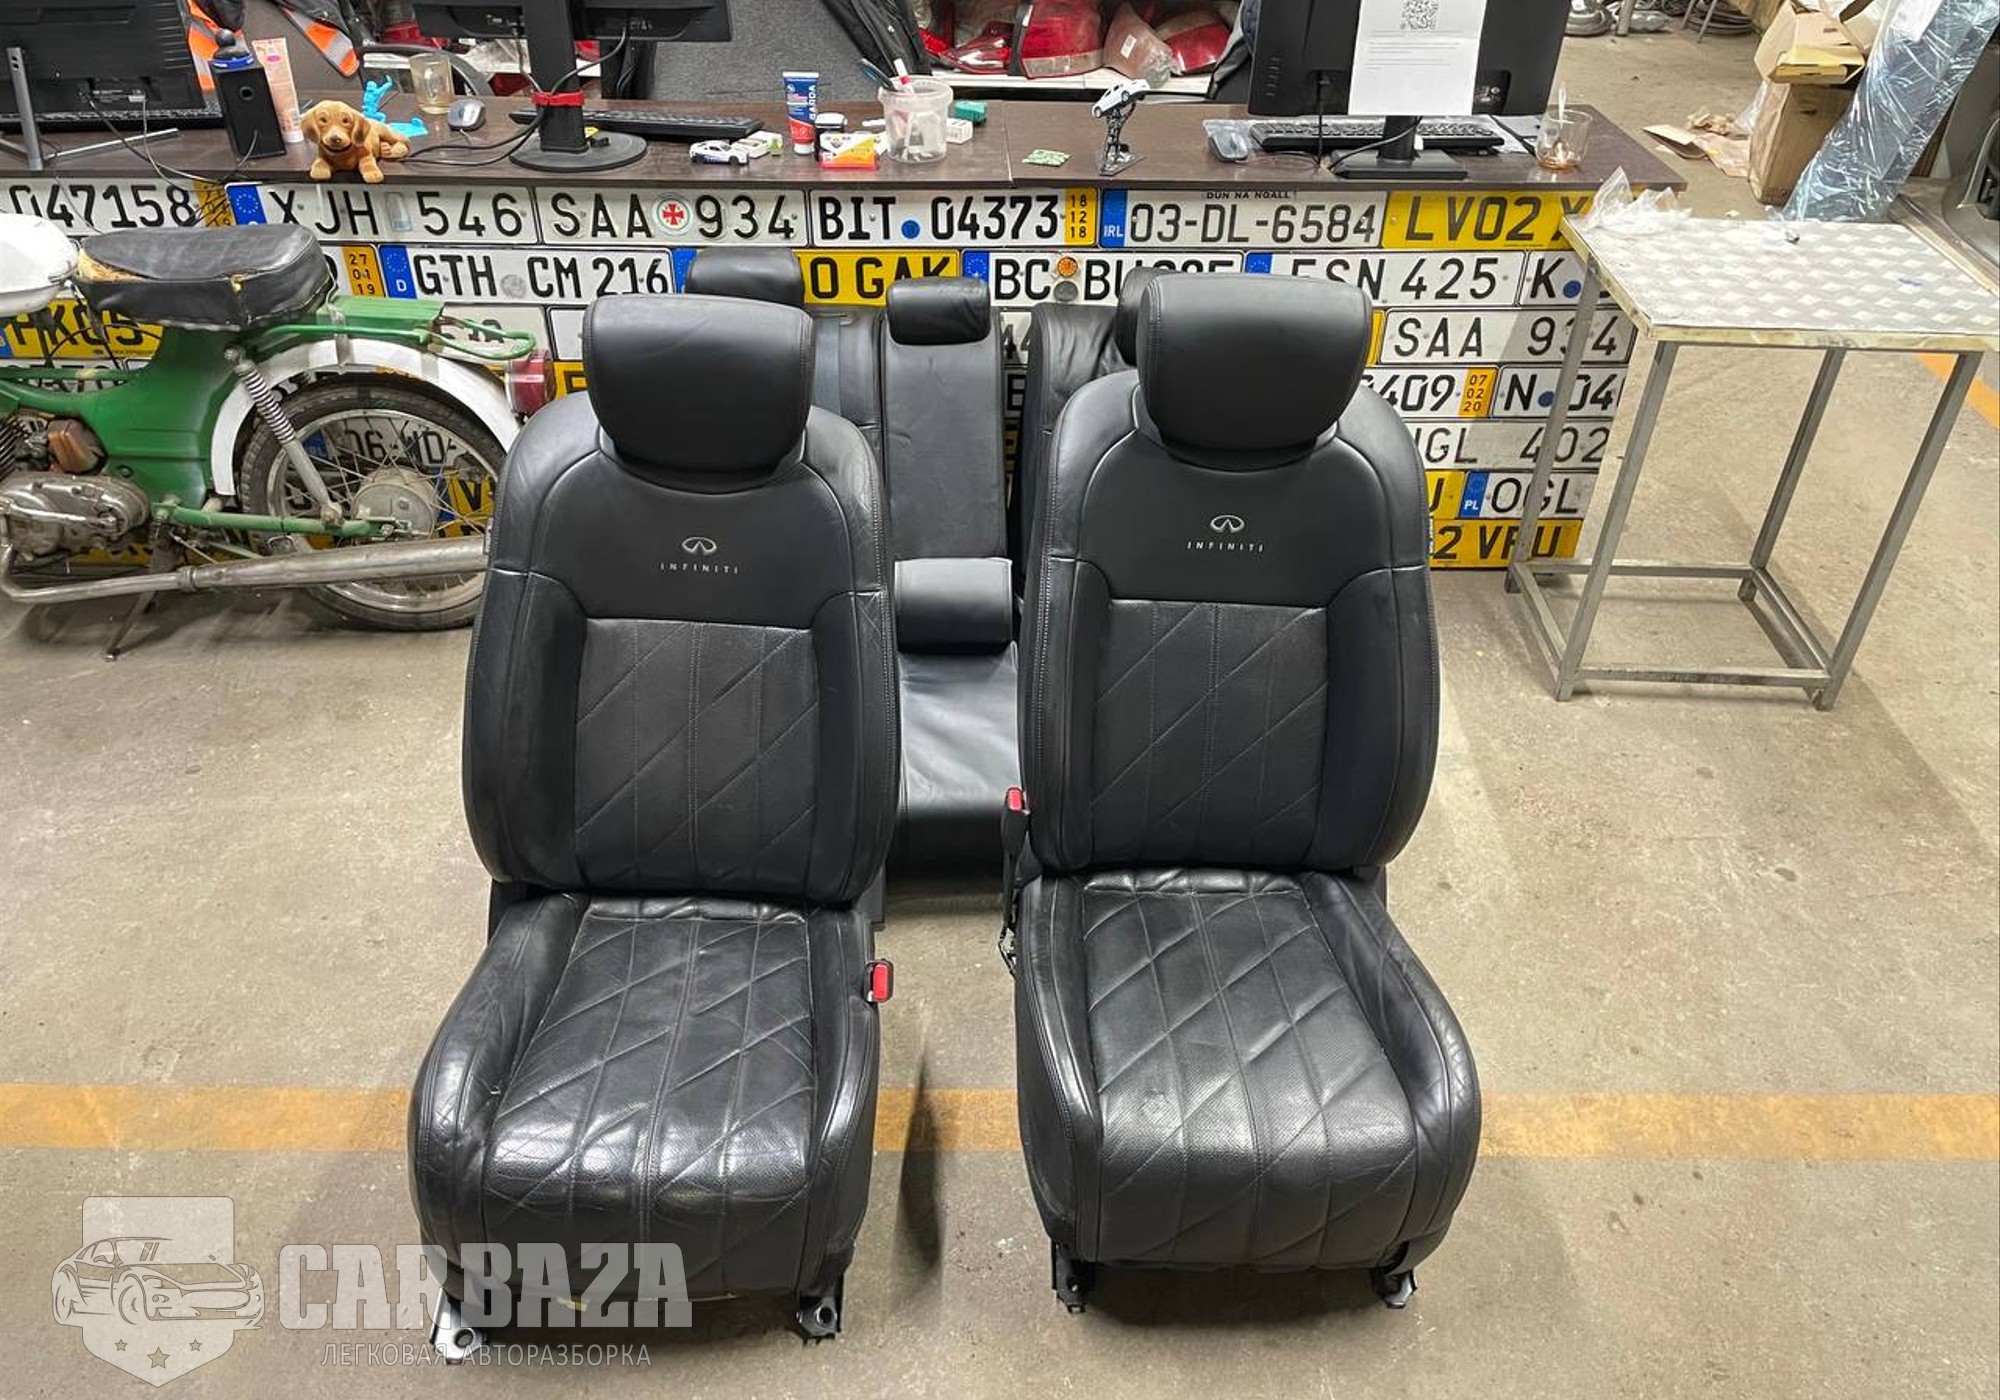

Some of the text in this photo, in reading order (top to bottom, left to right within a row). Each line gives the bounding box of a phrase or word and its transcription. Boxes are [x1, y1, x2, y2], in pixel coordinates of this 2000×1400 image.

[1070, 195, 1087, 207] 18
[315, 190, 378, 235] JH
[416, 191, 522, 237] 546
[551, 193, 795, 239] SAA 934
[820, 196, 1059, 240] BIT 04373
[1070, 211, 1086, 223] 12
[1070, 226, 1087, 238] 18
[1104, 225, 1124, 238] IRL
[412, 254, 668, 298] GTH CM 216
[995, 259, 1051, 300] BC
[1400, 258, 1499, 300] 425
[1530, 258, 1565, 299] K
[1394, 317, 1483, 357] SAA
[1470, 374, 1487, 385] 07
[1466, 388, 1484, 399] 02
[1503, 373, 1537, 411] N
[1463, 401, 1482, 412] 20
[1464, 500, 1480, 511] PL
[1186, 541, 1263, 552] INFINITI
[660, 562, 738, 574] INFINITI
